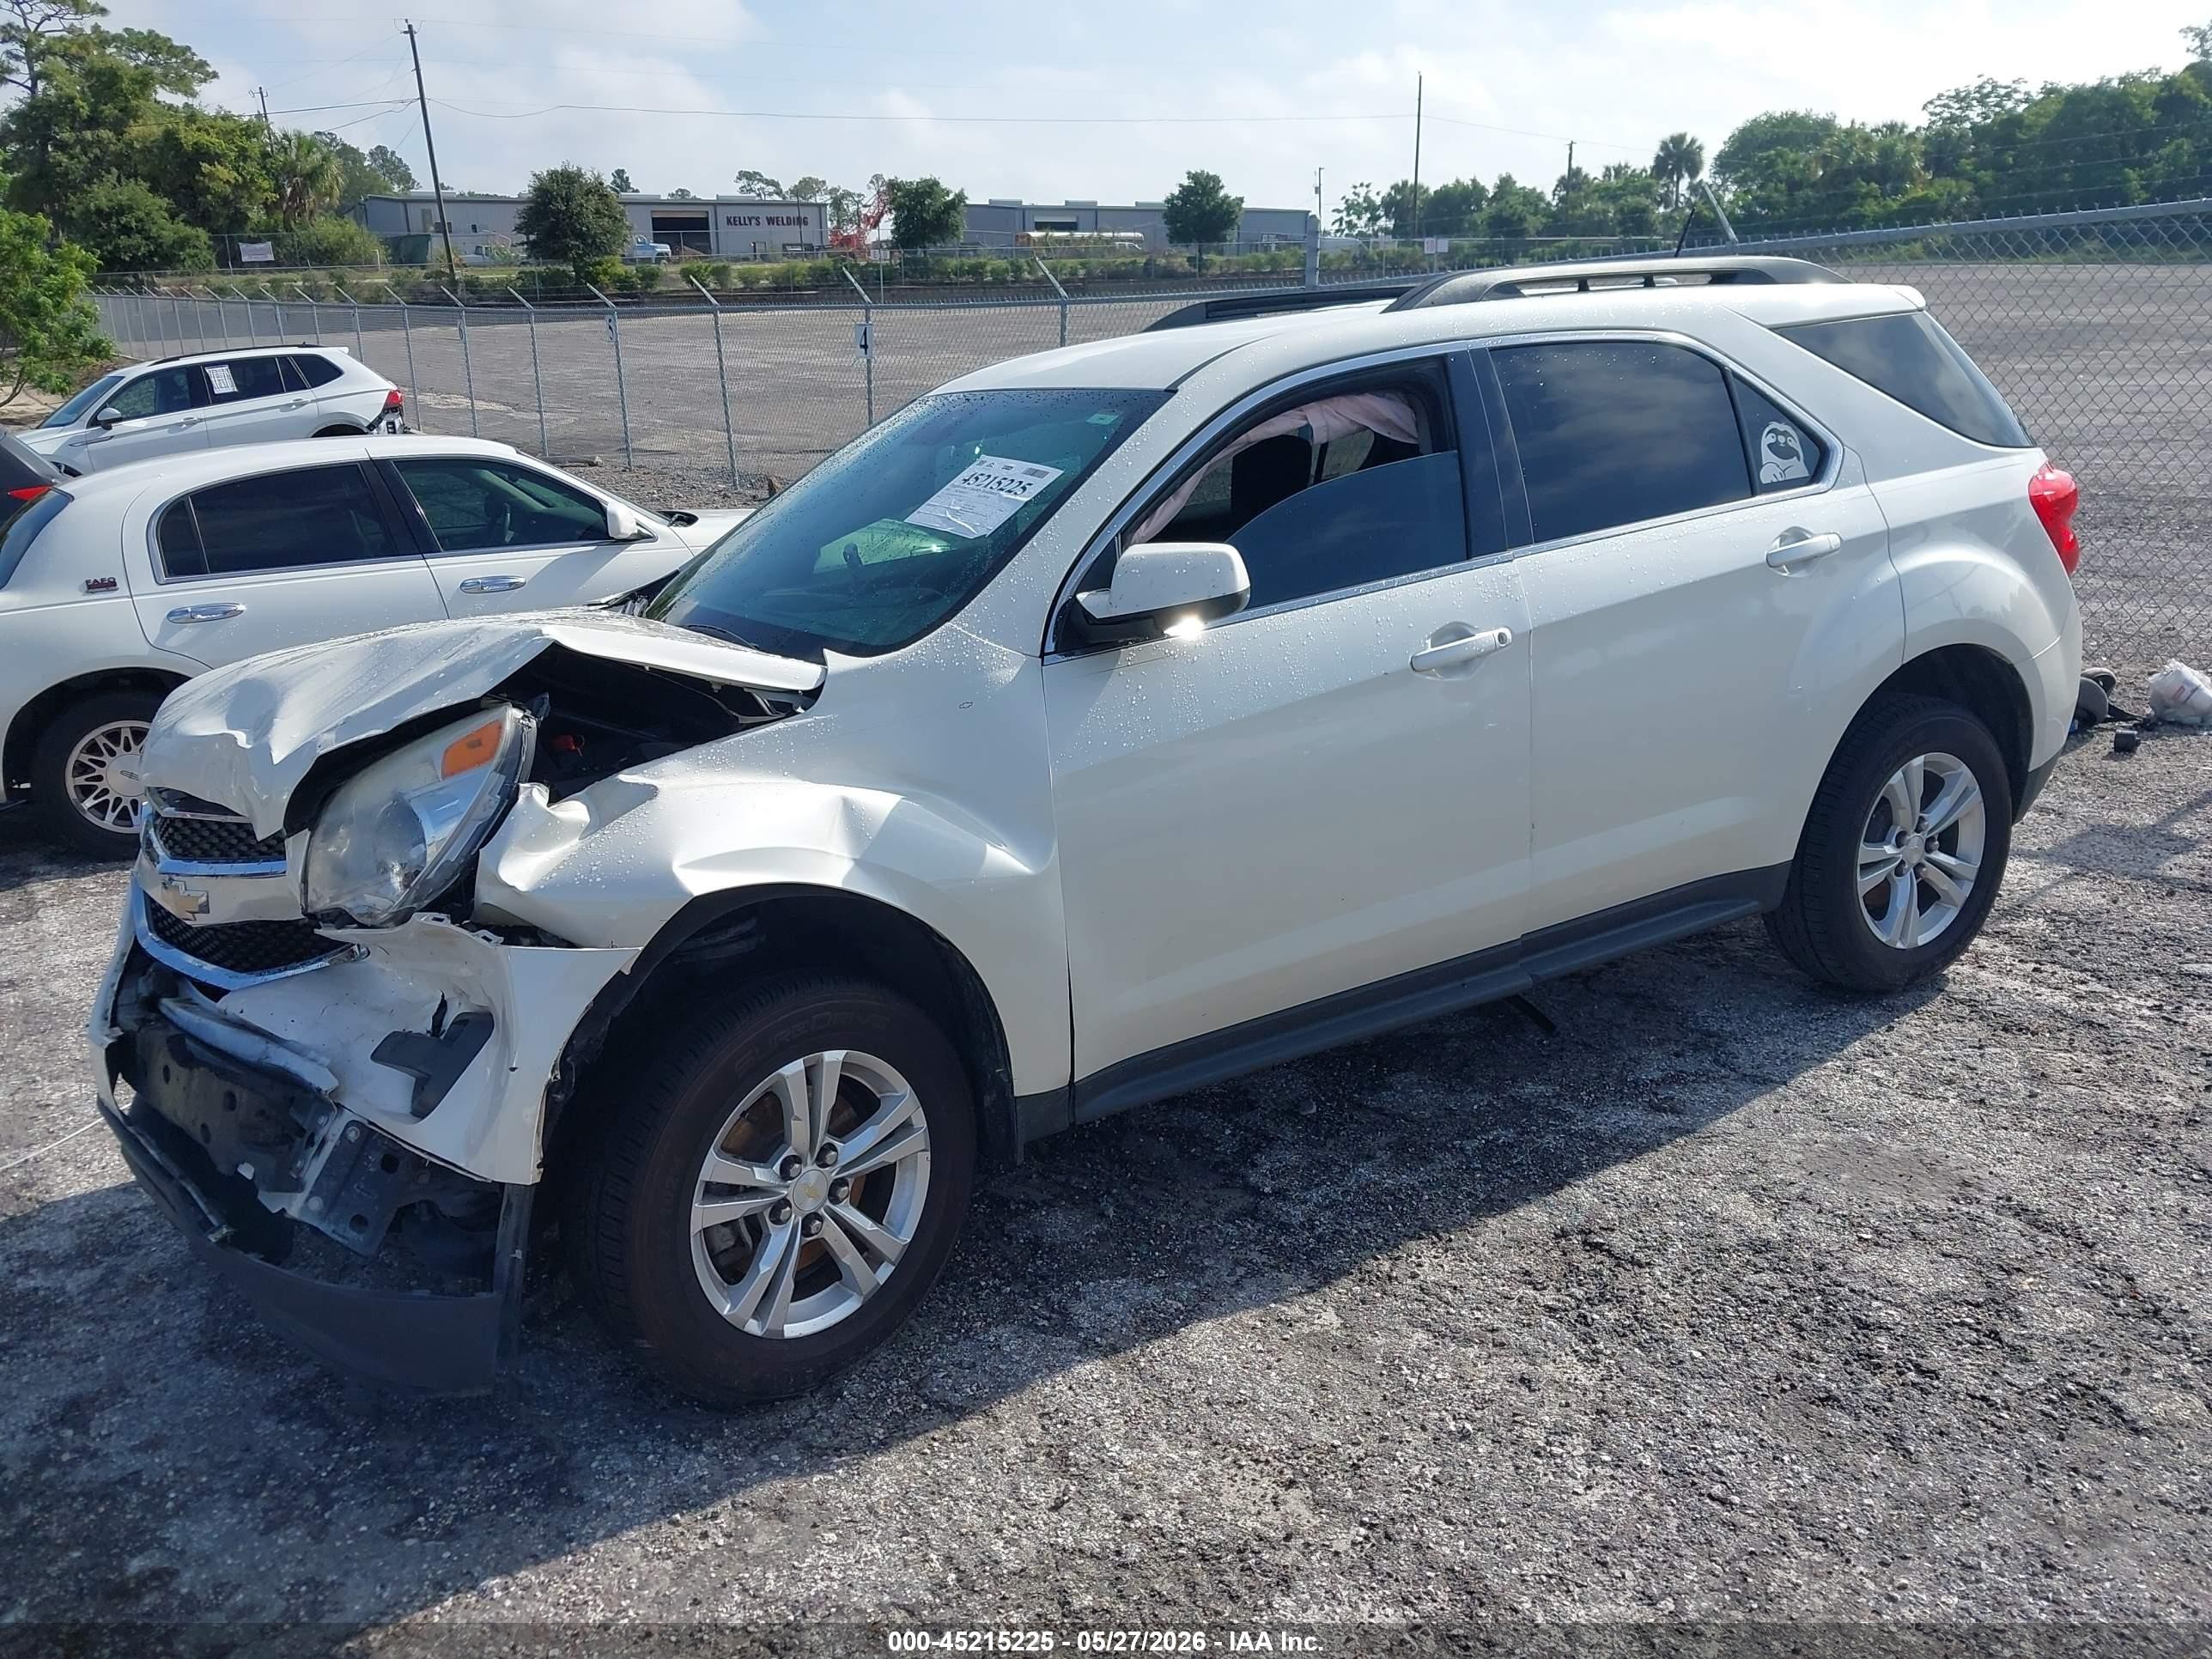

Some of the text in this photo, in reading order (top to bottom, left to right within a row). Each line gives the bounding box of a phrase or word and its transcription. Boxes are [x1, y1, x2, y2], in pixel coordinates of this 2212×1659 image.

[726, 216, 809, 227] KELLY'S WELDING
[859, 326, 869, 356] 4
[962, 471, 1034, 495] 45215225
